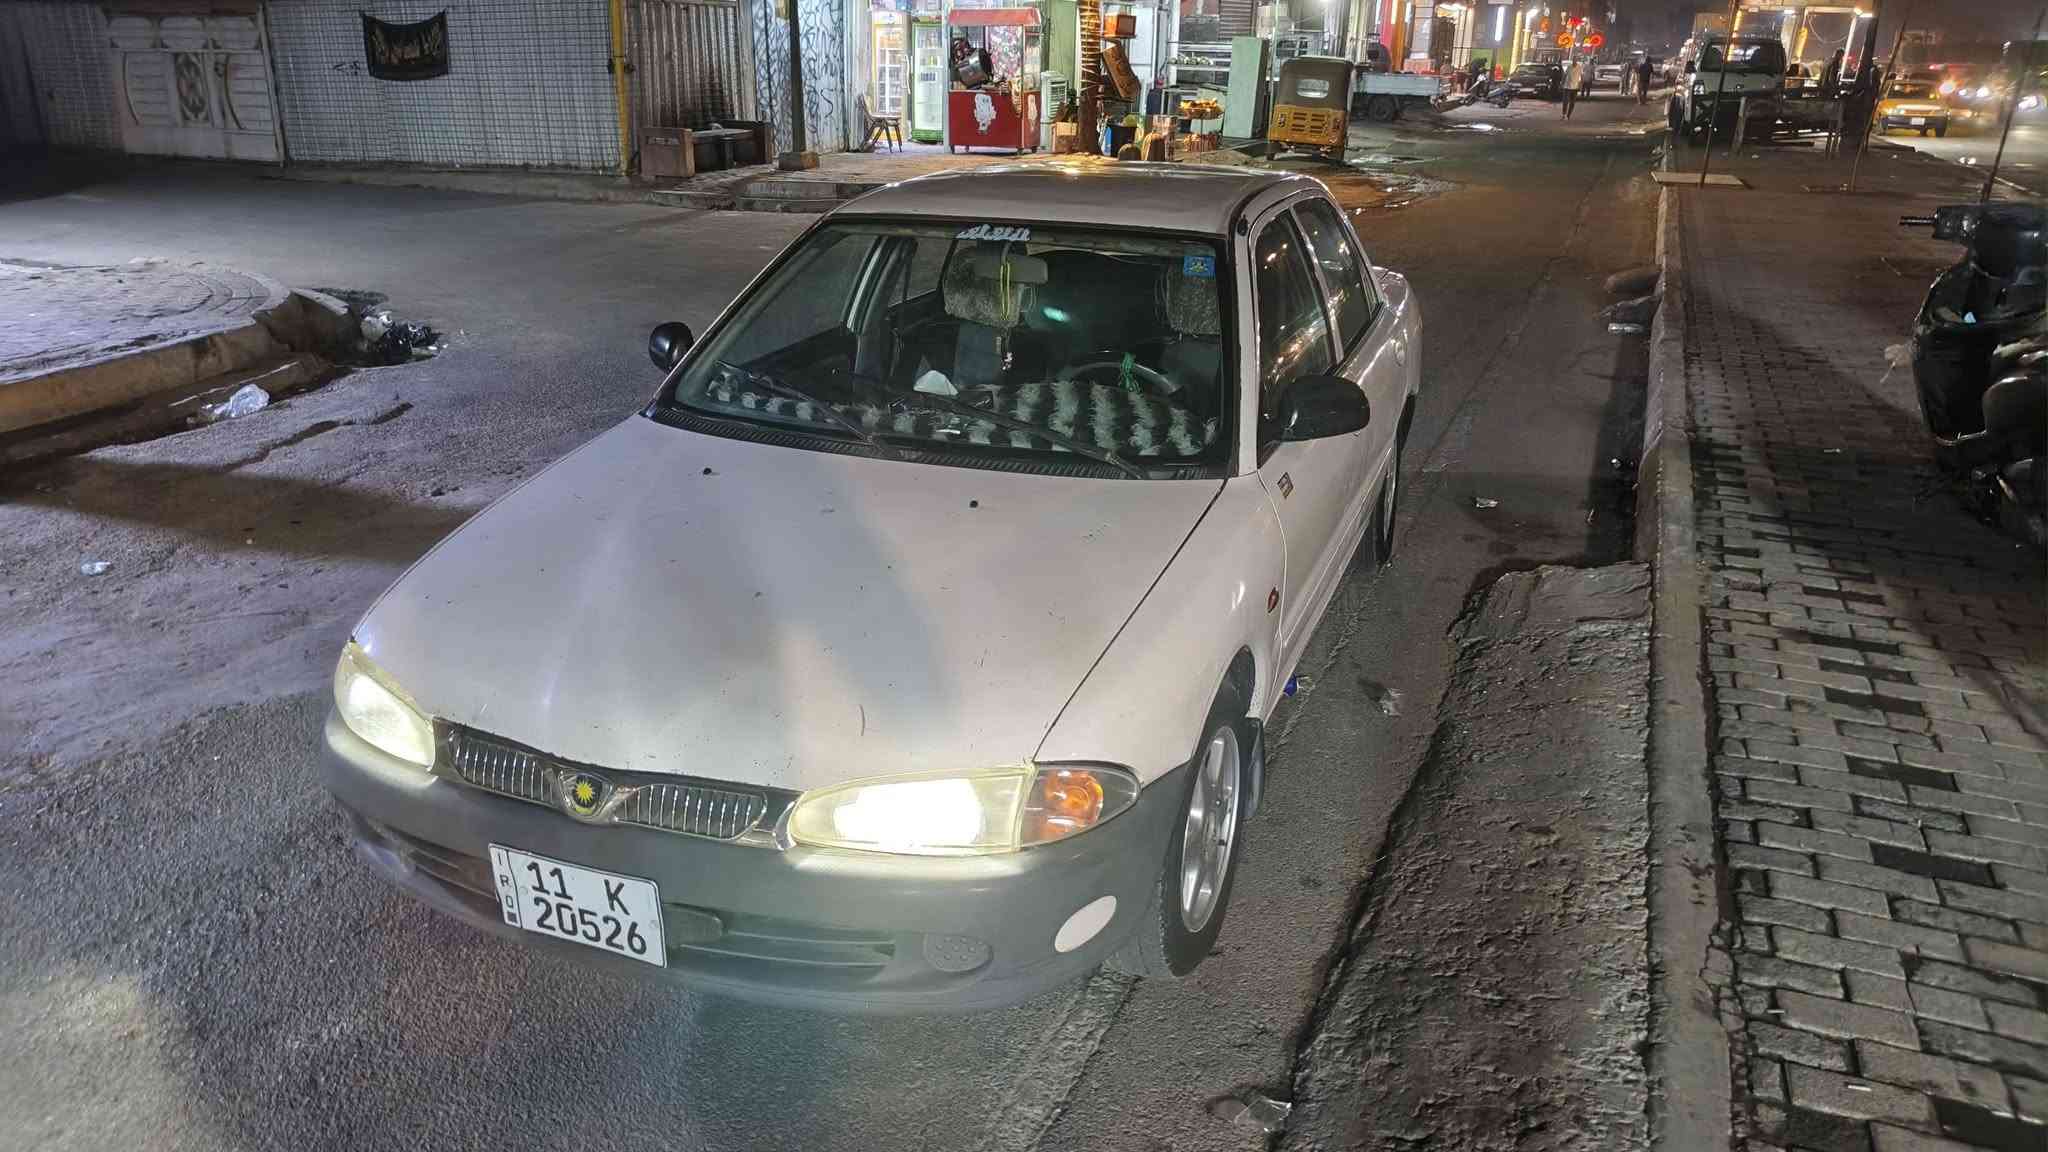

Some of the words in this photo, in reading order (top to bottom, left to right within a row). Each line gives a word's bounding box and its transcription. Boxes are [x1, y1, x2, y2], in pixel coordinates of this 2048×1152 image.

[527, 861, 573, 901] 11
[603, 878, 631, 916] K
[534, 896, 647, 956] 20526
